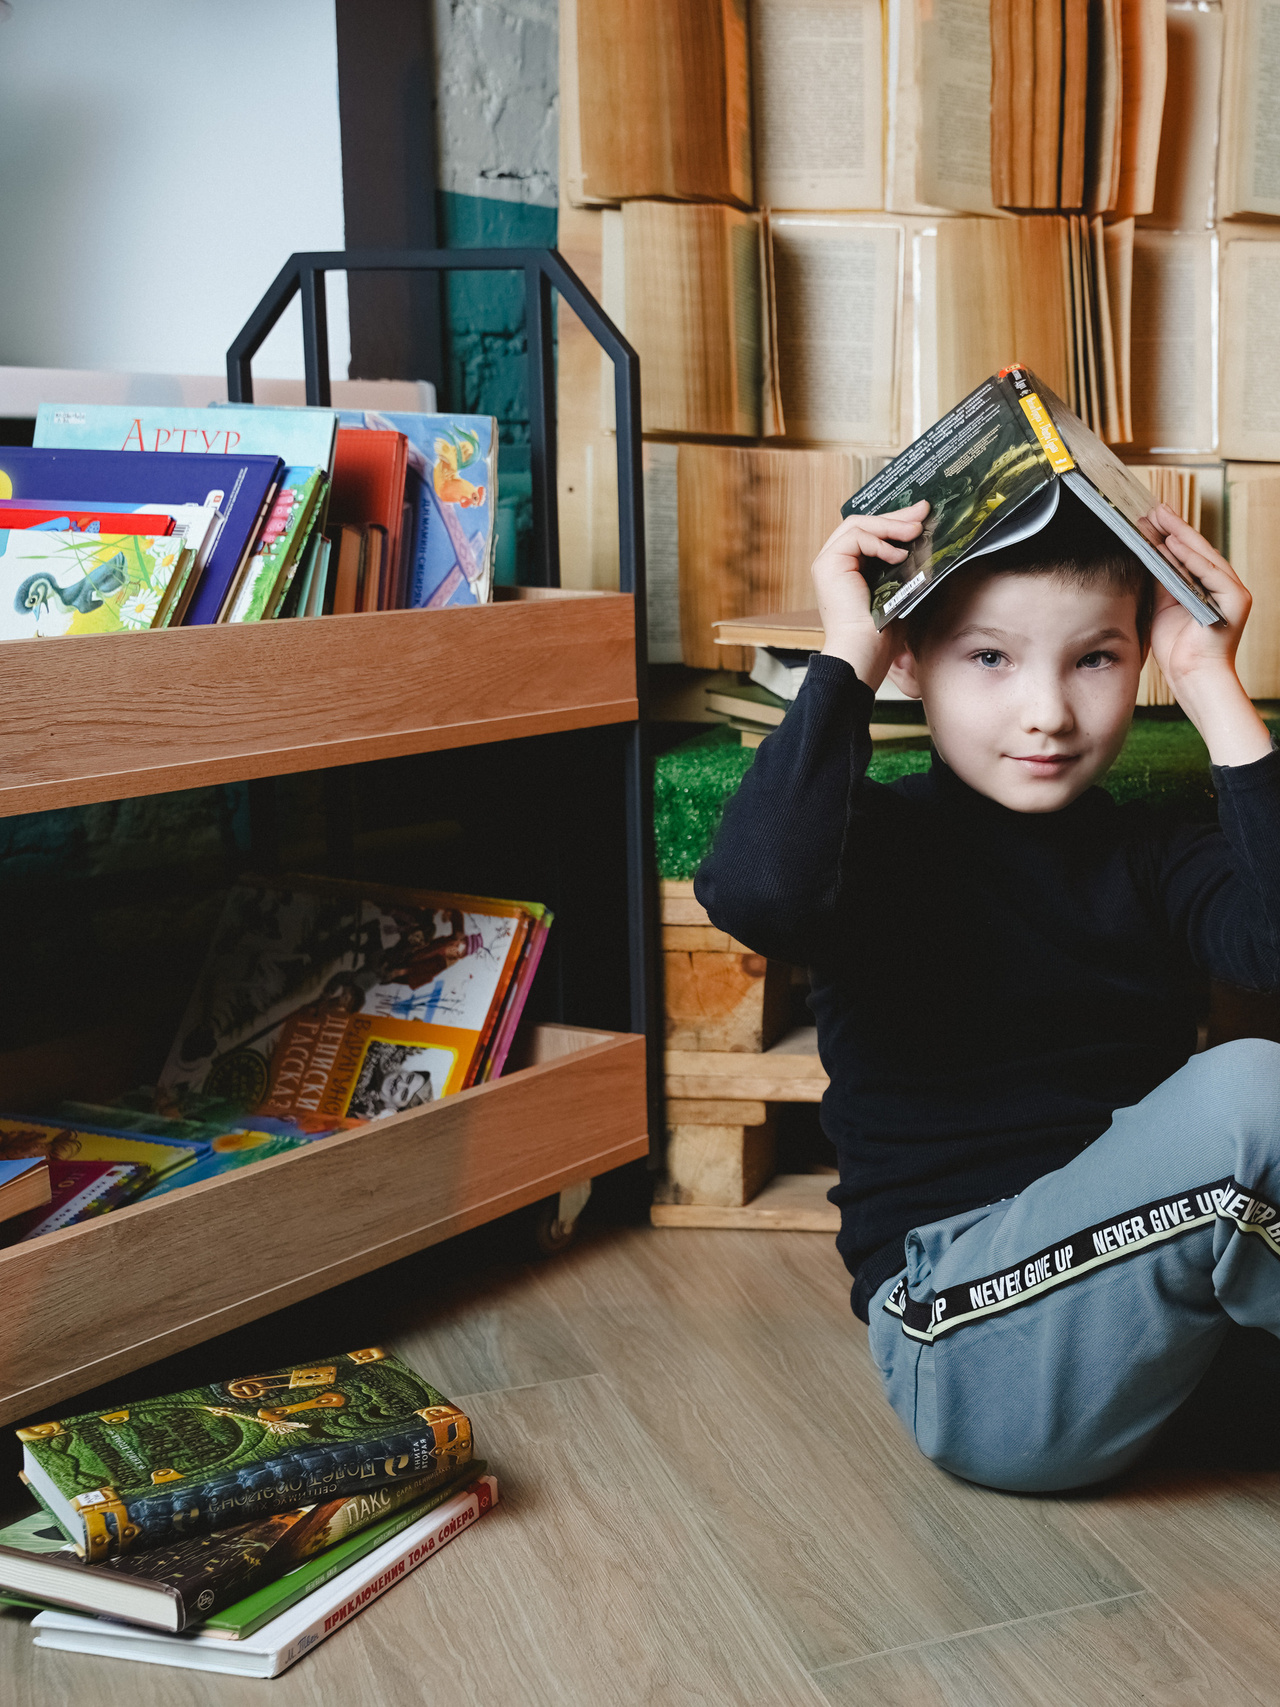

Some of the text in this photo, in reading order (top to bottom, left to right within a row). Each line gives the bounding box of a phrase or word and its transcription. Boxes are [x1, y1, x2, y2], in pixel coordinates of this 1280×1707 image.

[1092, 1188, 1226, 1256] NEVER GIVE UP
[1220, 1182, 1277, 1226] NEVER
[969, 1244, 1074, 1310] NEVER GIVE UP
[413, 1440, 421, 1471] КНИГА
[420, 1438, 429, 1470] ВТОРАЯ
[346, 1487, 391, 1525] ПАКС
[396, 1485, 412, 1498] САРА
[324, 1560, 405, 1634] ПРИКЛЮЧЕНИЯ
[297, 1633, 319, 1654] Твен
